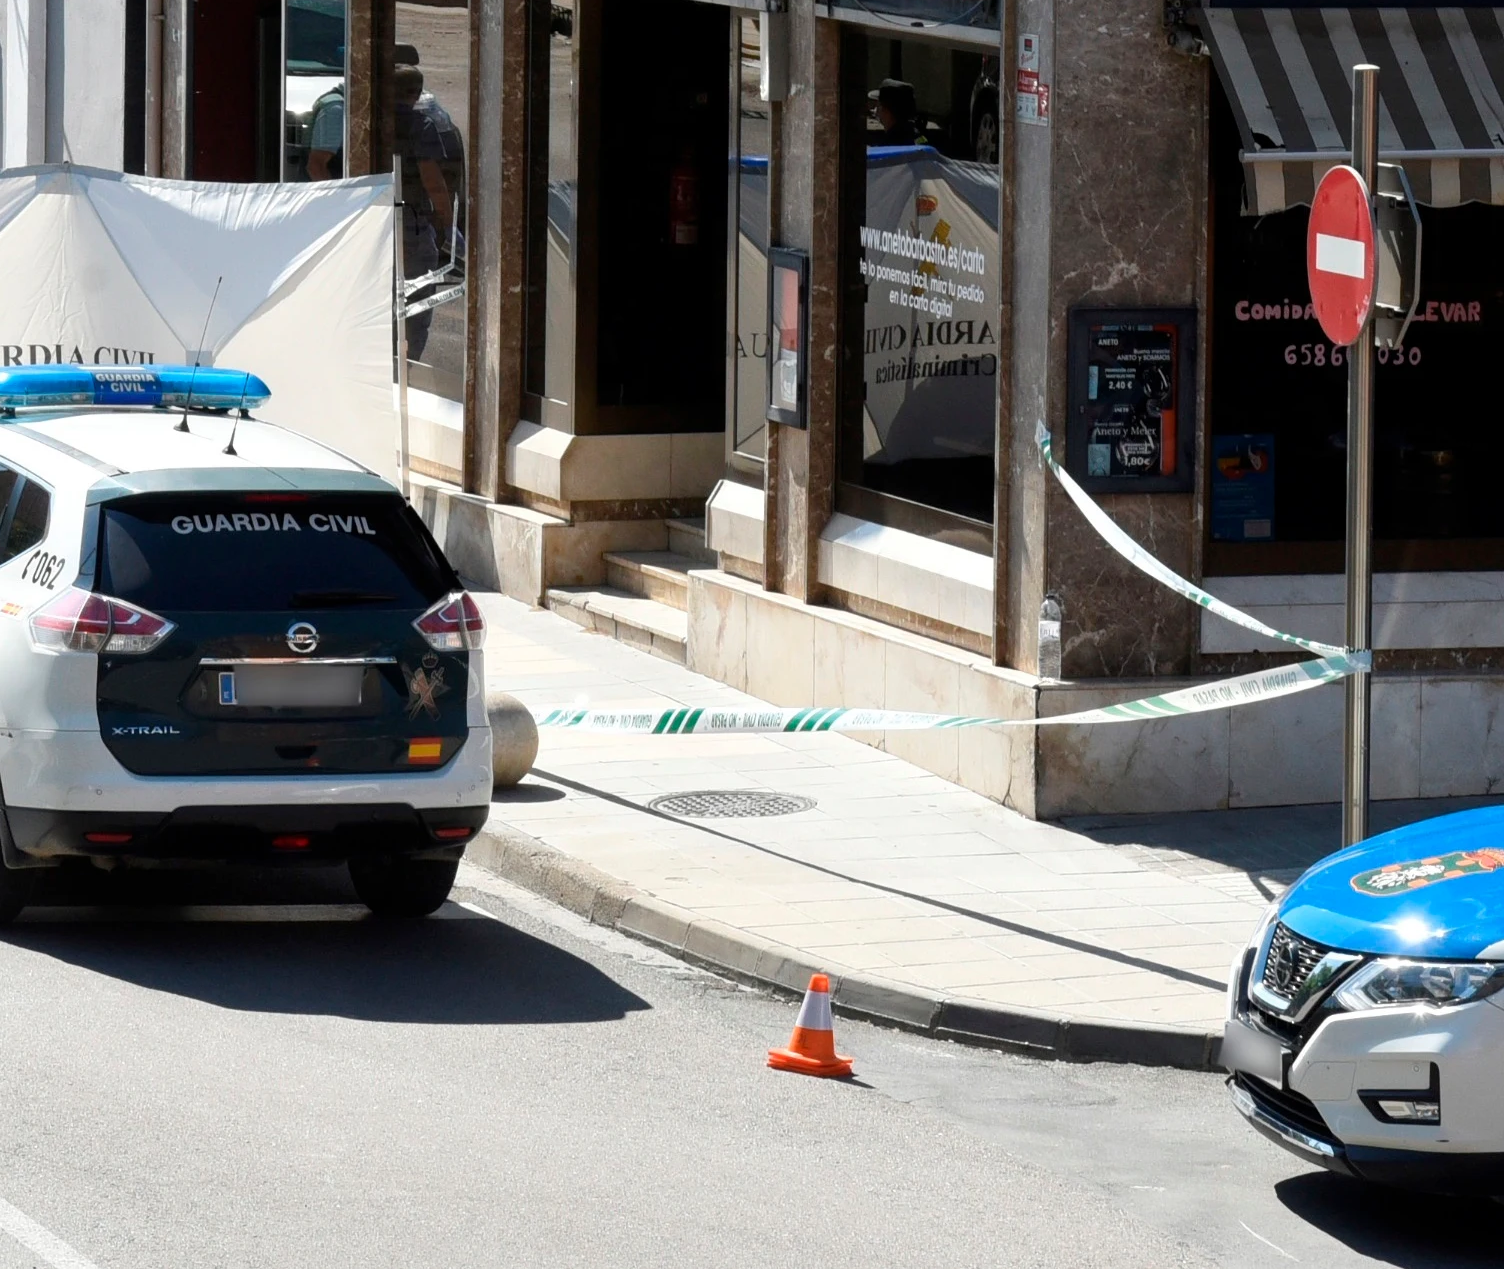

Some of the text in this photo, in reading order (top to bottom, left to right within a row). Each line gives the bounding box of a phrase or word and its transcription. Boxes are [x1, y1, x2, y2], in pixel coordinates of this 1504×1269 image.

[860, 226, 985, 275] www.anetobarbastro.es/carta
[860, 257, 867, 275] te
[868, 259, 876, 277] lo
[876, 264, 910, 285] ponemos
[930, 276, 947, 294] mira
[948, 278, 956, 297] tu
[957, 283, 985, 304] pedido
[889, 288, 953, 319] en la carta digital
[95, 373, 155, 382] GUARDIA
[111, 382, 145, 392] CIVIL
[171, 513, 376, 535] GUARDIA CIVIL
[32, 552, 66, 590] 062
[112, 726, 180, 736] X-TRAIL
